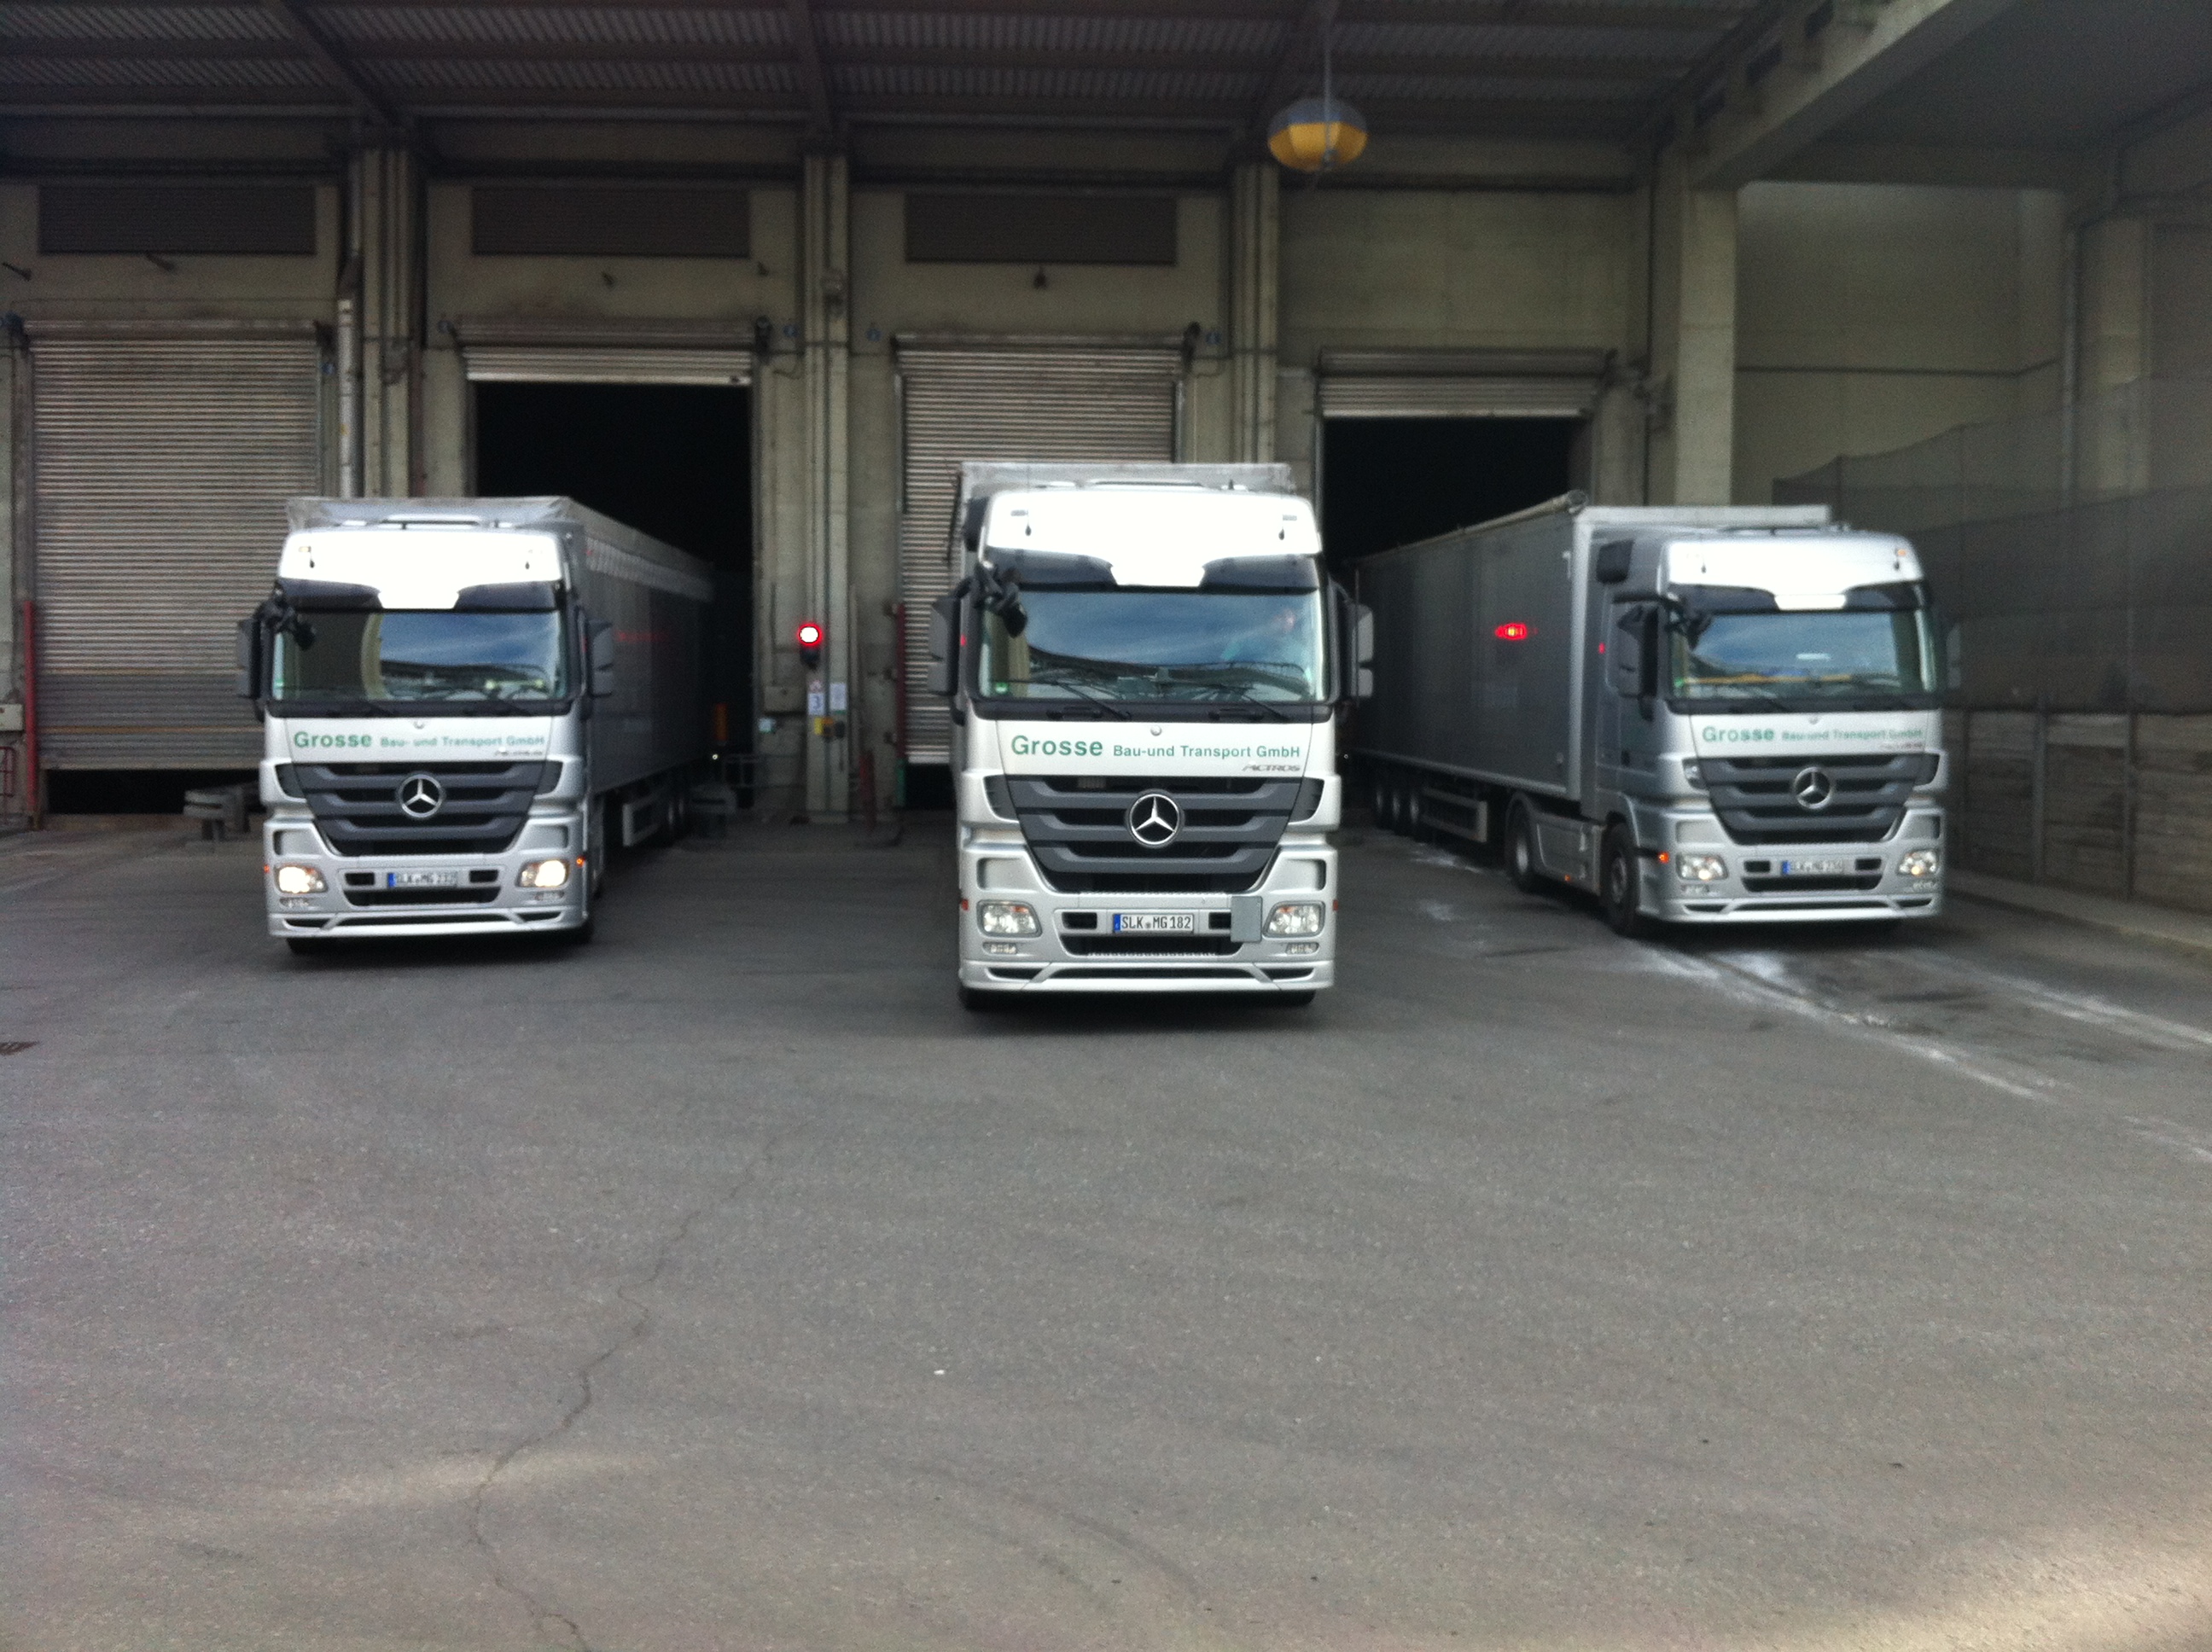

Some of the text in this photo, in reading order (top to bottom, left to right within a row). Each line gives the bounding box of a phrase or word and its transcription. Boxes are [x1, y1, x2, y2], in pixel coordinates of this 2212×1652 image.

[294, 731, 372, 748] Grosse
[442, 736, 504, 748] Transport
[505, 736, 546, 746] GmbH
[1702, 725, 1775, 742] Grosse
[1010, 735, 1301, 759] Grosse Bau-und Transport GmbH
[1121, 916, 1191, 929] SLK MG 182
